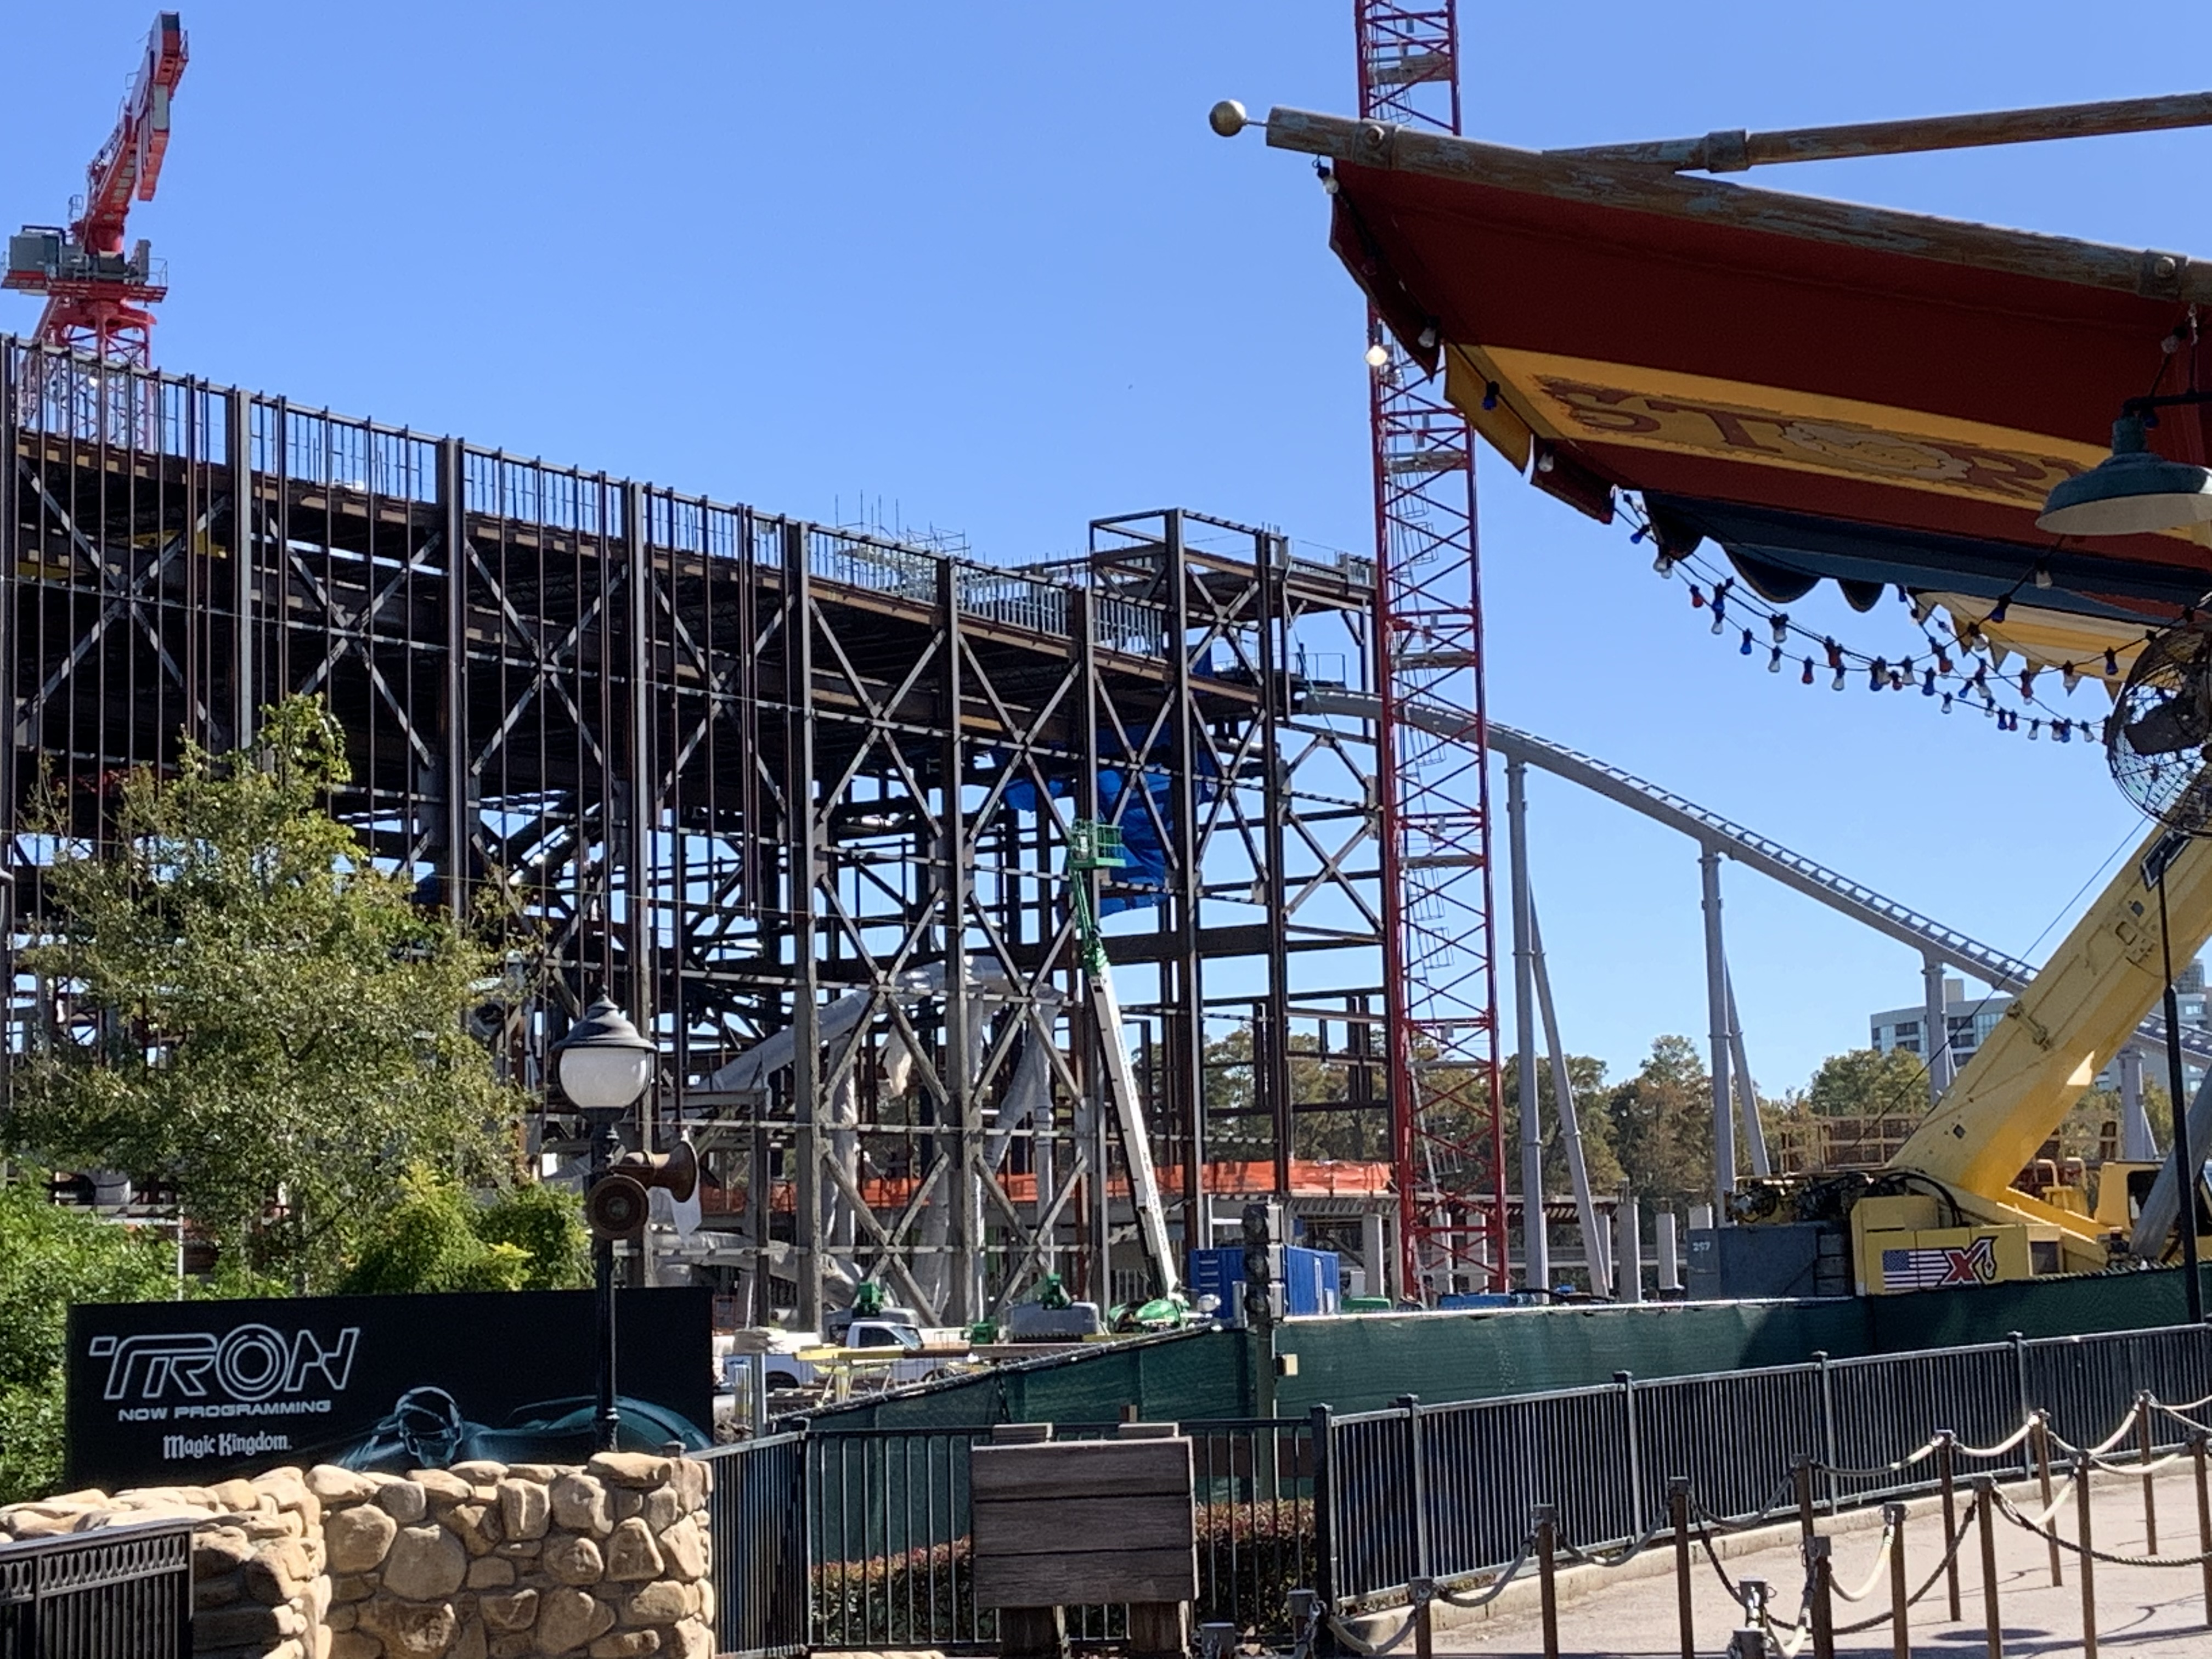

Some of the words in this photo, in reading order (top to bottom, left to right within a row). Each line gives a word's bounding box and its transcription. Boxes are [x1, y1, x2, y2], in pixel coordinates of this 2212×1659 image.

[89, 1323, 360, 1402] TRON
[118, 1408, 168, 1421] NOW
[173, 1400, 332, 1419] PROGRAMMING
[163, 1435, 216, 1459] Magic
